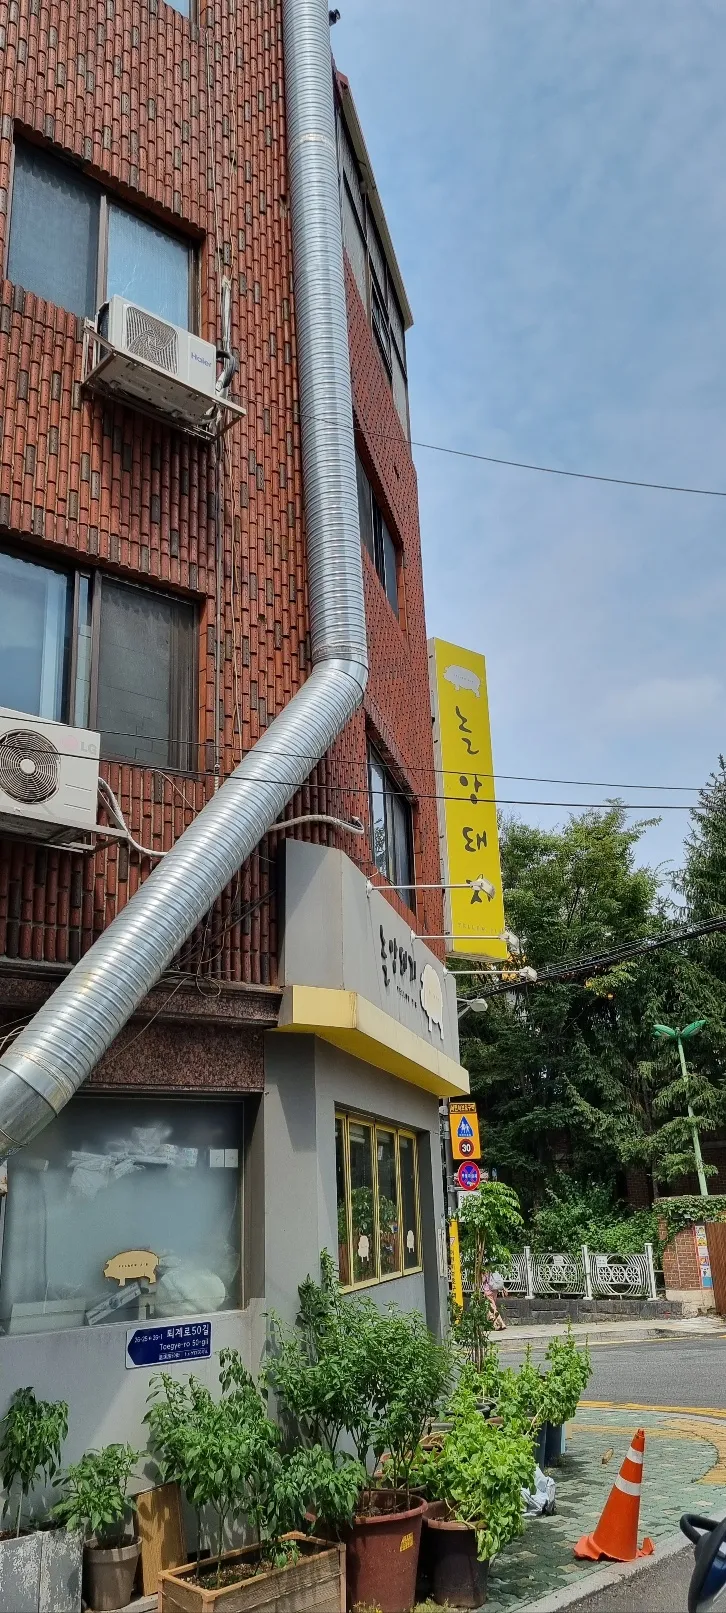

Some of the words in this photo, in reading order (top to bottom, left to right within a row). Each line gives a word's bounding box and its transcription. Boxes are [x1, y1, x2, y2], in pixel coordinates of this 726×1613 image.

[191, 352, 212, 368] Haier
[80, 741, 97, 755] LG
[461, 1143, 472, 1153] 30
[167, 1323, 209, 1339] 퇴계로50길
[159, 1341, 191, 1351] Toegye-ro
